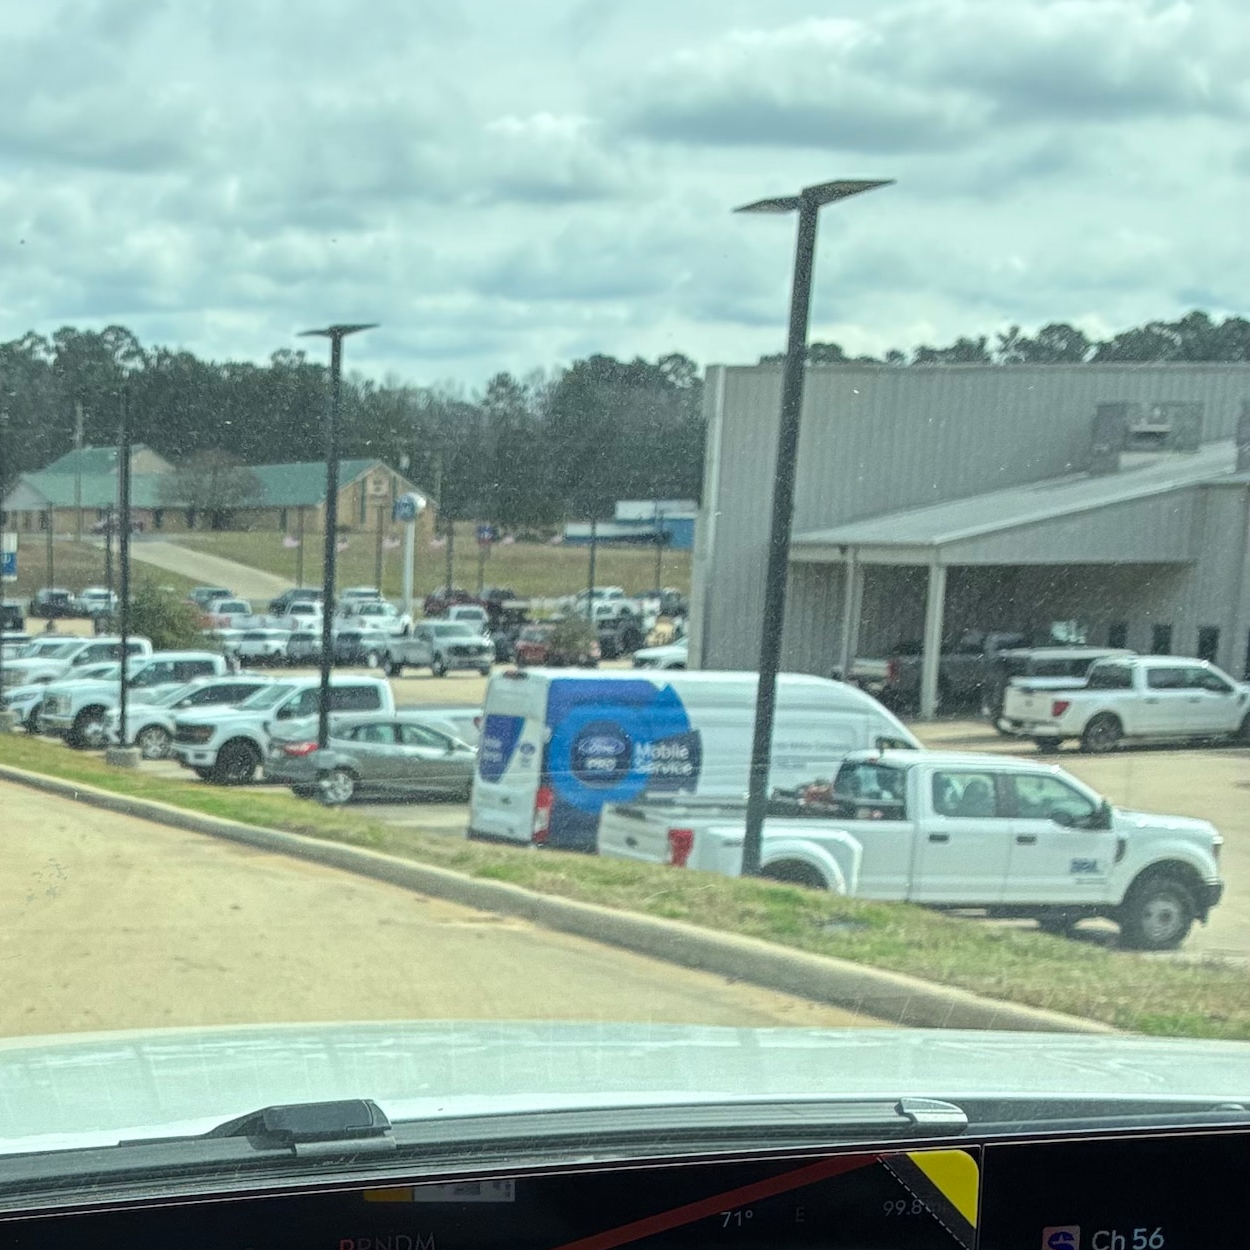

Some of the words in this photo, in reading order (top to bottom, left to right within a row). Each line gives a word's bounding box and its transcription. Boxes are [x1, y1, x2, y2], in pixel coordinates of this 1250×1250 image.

[634, 741, 689, 760] Mobile
[585, 757, 617, 771] PRO
[634, 758, 693, 776] Service
[1132, 1226, 1166, 1250] 56
